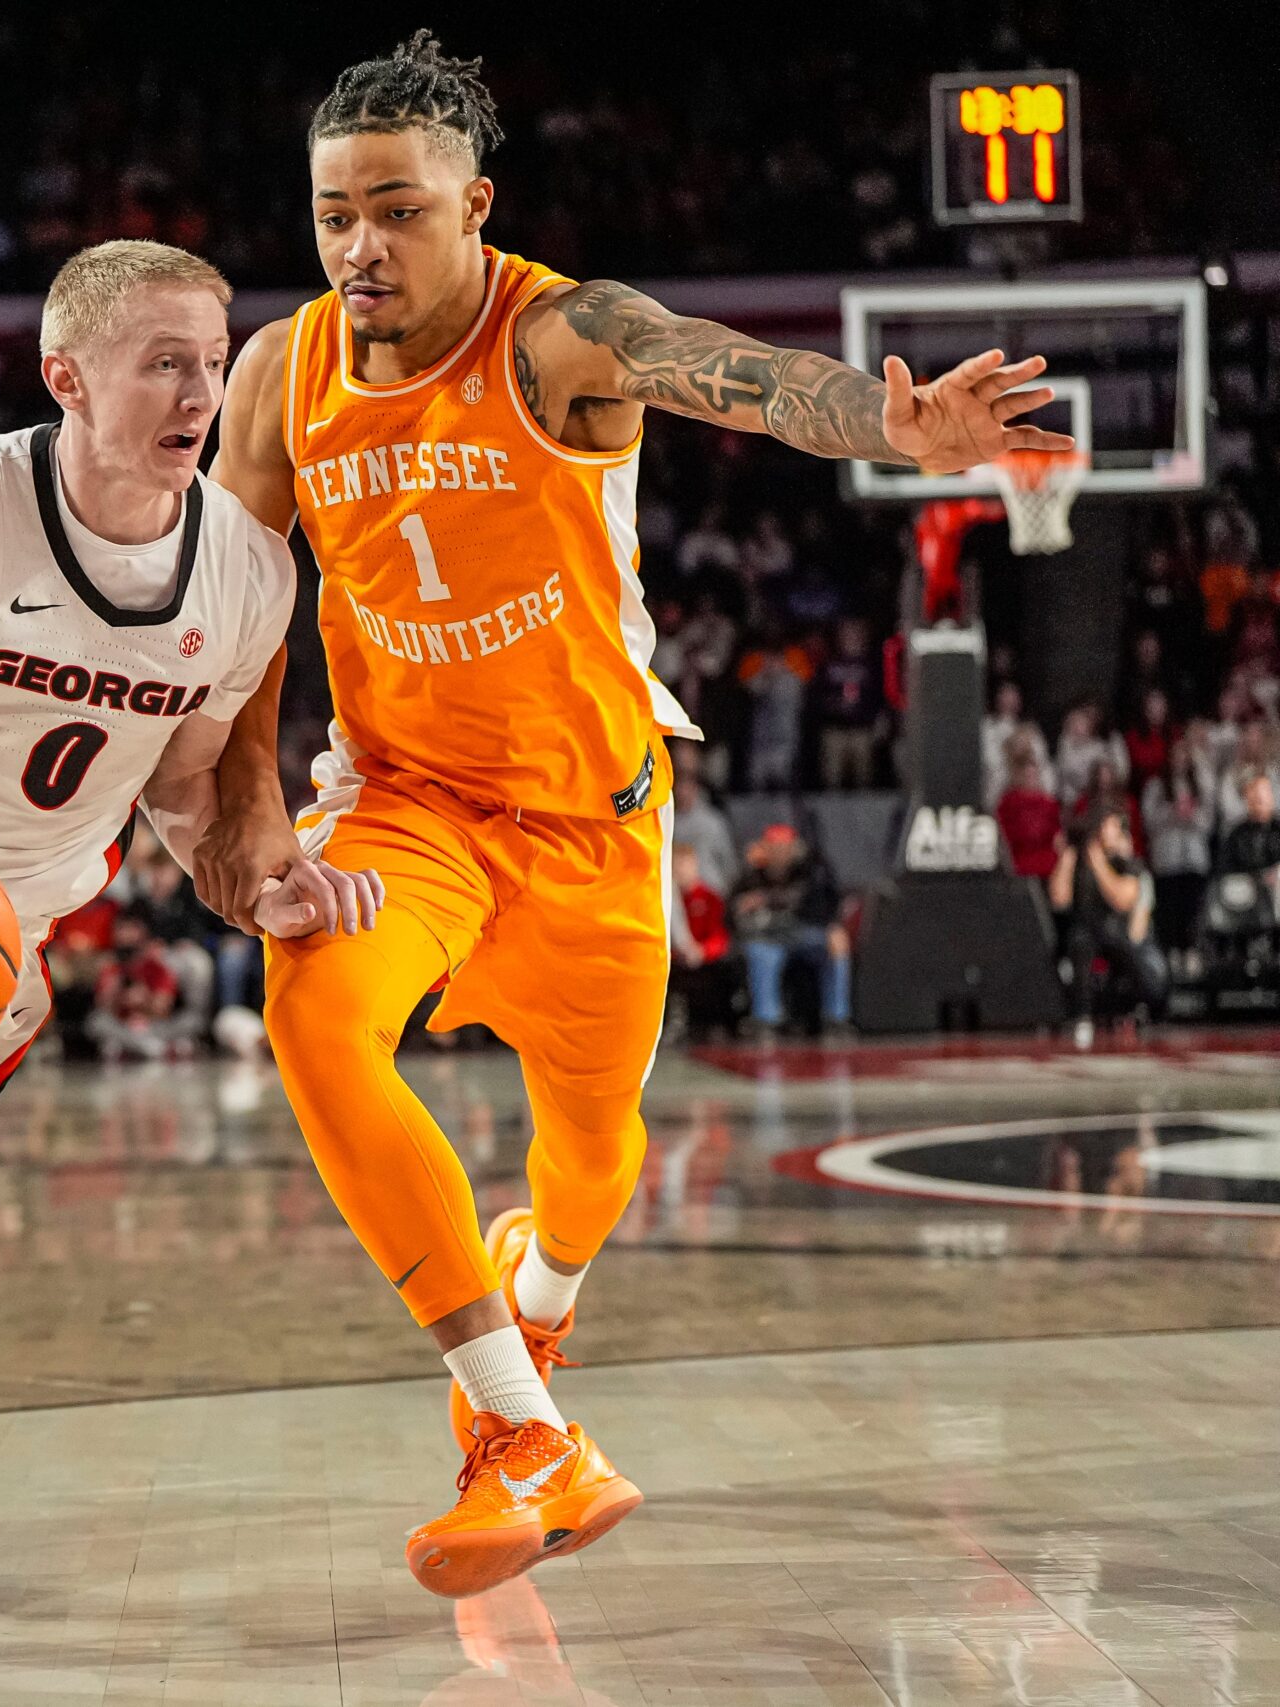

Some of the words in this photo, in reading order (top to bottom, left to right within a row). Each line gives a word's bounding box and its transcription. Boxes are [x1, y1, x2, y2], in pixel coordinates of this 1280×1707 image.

[463, 376, 482, 402] SEC
[298, 441, 517, 509] TENNESSEE
[398, 513, 452, 602] 1
[182, 631, 201, 655] SEC
[21, 721, 108, 811] 0
